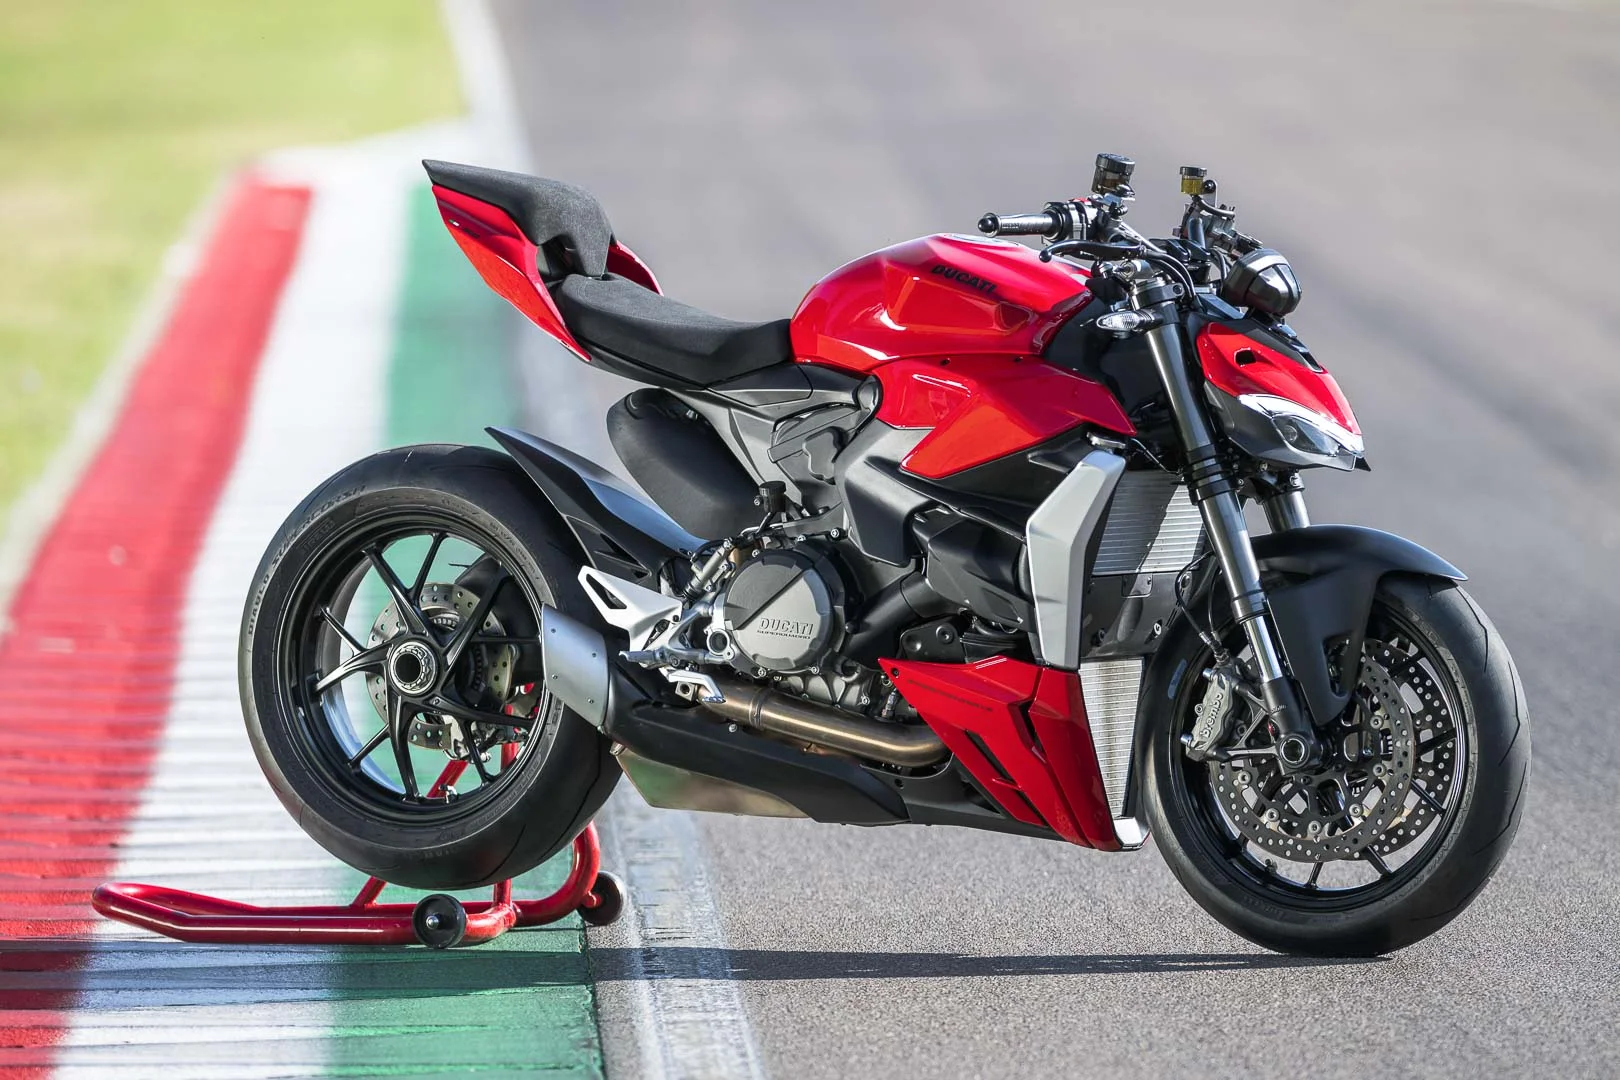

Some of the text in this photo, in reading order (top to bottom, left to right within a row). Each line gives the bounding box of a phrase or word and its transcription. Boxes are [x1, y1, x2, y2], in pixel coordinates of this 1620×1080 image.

[931, 264, 996, 293] DUCATI
[759, 617, 814, 635] DUCATI
[1199, 692, 1224, 739] brembo
